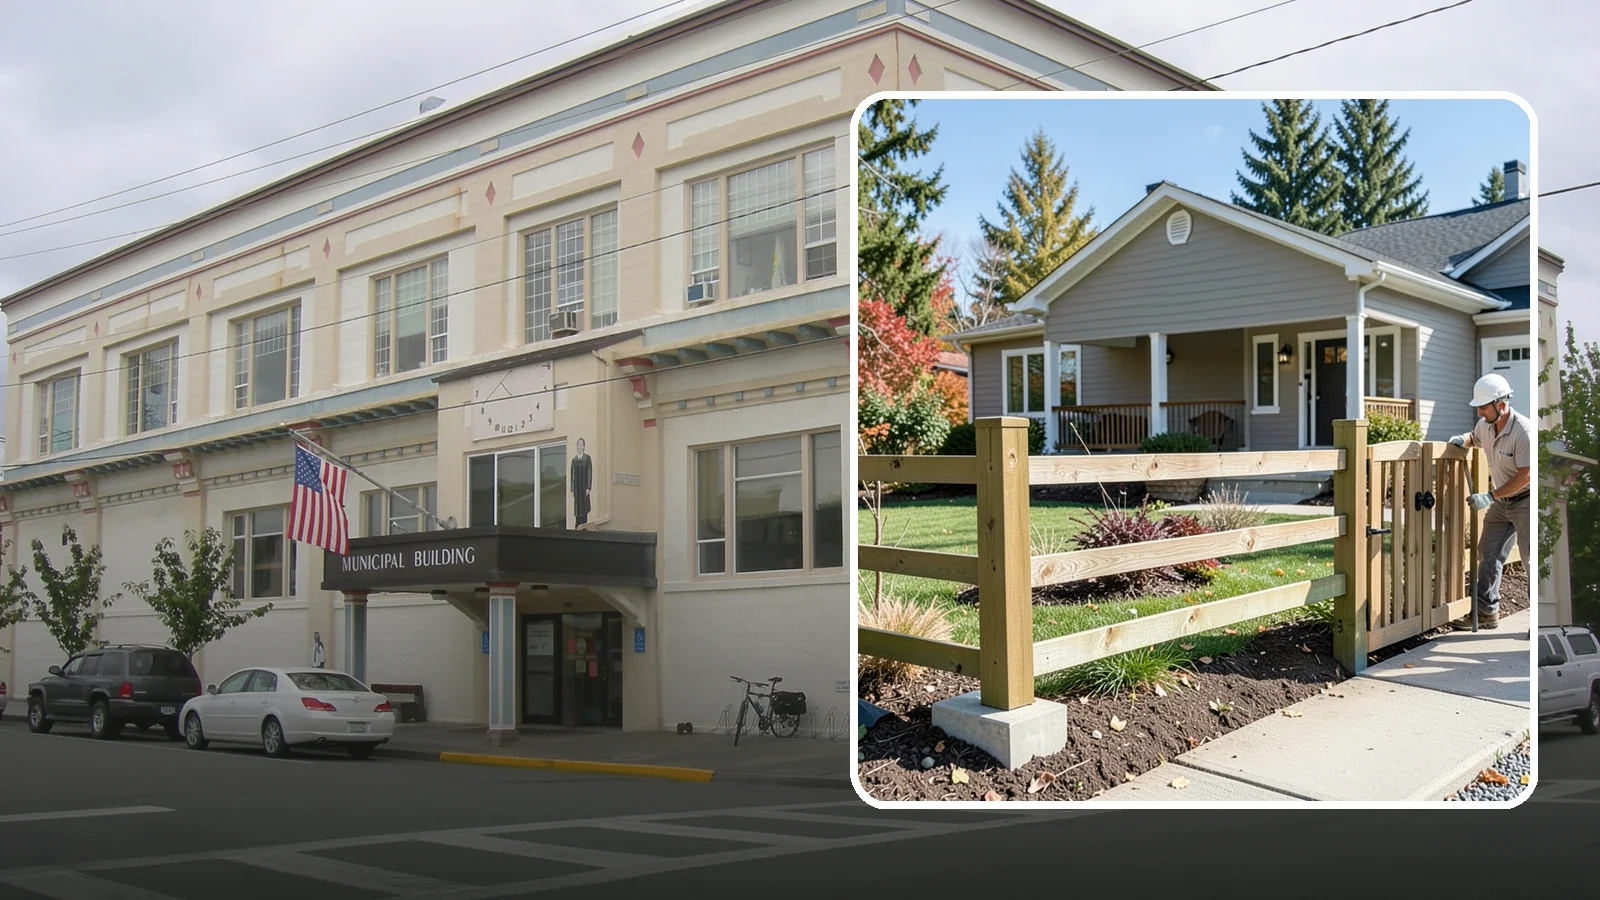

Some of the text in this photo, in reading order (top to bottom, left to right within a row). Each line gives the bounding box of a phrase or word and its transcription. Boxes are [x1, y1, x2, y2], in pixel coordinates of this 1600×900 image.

[536, 402, 540, 410] 4
[480, 407, 485, 415] 8
[487, 417, 492, 426] 9
[528, 414, 533, 422] 3
[494, 423, 500, 432] 10
[521, 420, 525, 428] 2
[501, 425, 506, 433] 11
[507, 425, 513, 433] 12
[342, 546, 475, 572] MUNICIPAL BUILDING
